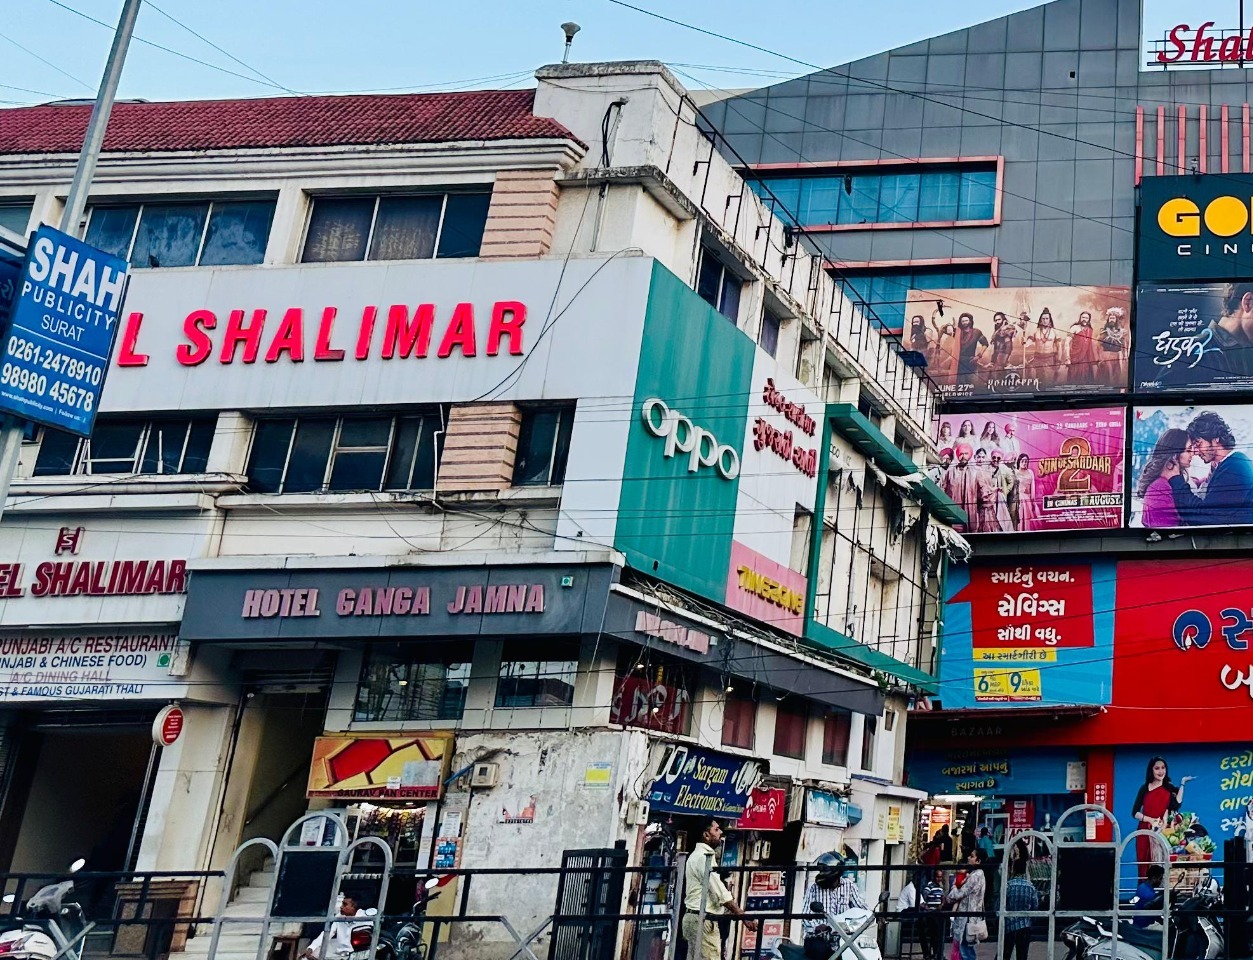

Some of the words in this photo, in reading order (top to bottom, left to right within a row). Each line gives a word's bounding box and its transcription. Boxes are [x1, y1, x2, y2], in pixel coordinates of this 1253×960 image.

[29, 237, 126, 312] SHAH
[21, 280, 117, 330] PUBLICITY
[41, 314, 85, 341] SURAT
[176, 300, 529, 368] SHALIMAR
[7, 335, 102, 386] 0261-2478910
[1, 362, 47, 397] 98980
[49, 380, 95, 413] 45678
[642, 398, 740, 481] oppo
[1038, 458, 1058, 478] SON
[1066, 455, 1112, 475] SARDAAR
[31, 559, 188, 597] SHALIMAR
[241, 588, 320, 618] HOTEL
[335, 586, 431, 617] GANGA
[446, 584, 546, 614] JAMNA
[0, 656, 36, 669] NJABI
[39, 656, 47, 668] &
[51, 655, 105, 668] CHINESE
[108, 654, 147, 668] FOOD)
[55, 636, 82, 655] A/C
[84, 634, 178, 654] RESTAURANT
[21, 685, 62, 696] FAMOUS
[66, 684, 114, 696] GUJARATI
[115, 683, 144, 695] THALI
[35, 671, 78, 684] DINING
[81, 670, 112, 682] HALL
[693, 756, 729, 790] Sargam
[336, 788, 376, 798] GAURAV
[378, 788, 397, 797] PAN
[400, 788, 438, 798] CENTER
[673, 784, 724, 812] Electronics
